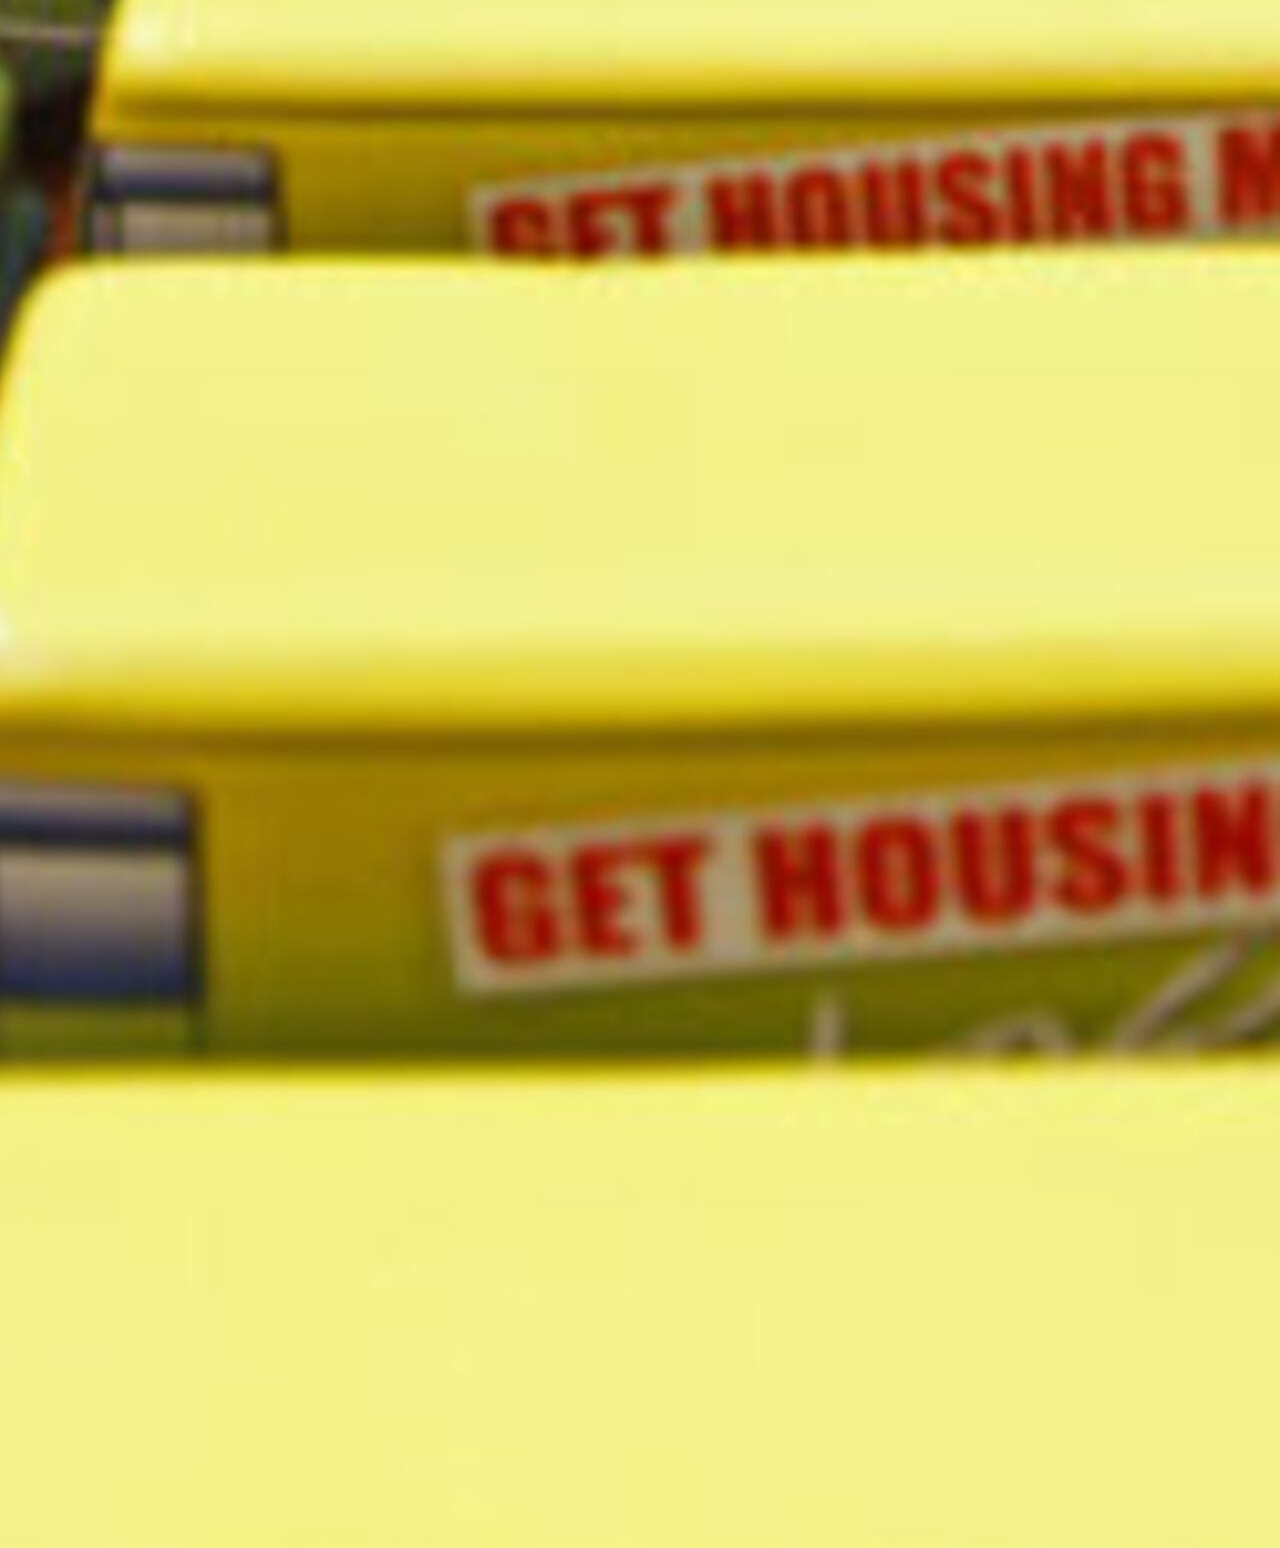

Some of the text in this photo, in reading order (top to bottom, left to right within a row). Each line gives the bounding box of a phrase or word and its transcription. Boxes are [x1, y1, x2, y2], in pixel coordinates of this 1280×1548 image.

[488, 183, 680, 256] GET
[708, 131, 1188, 249] HOUSING
[469, 834, 706, 967] GET
